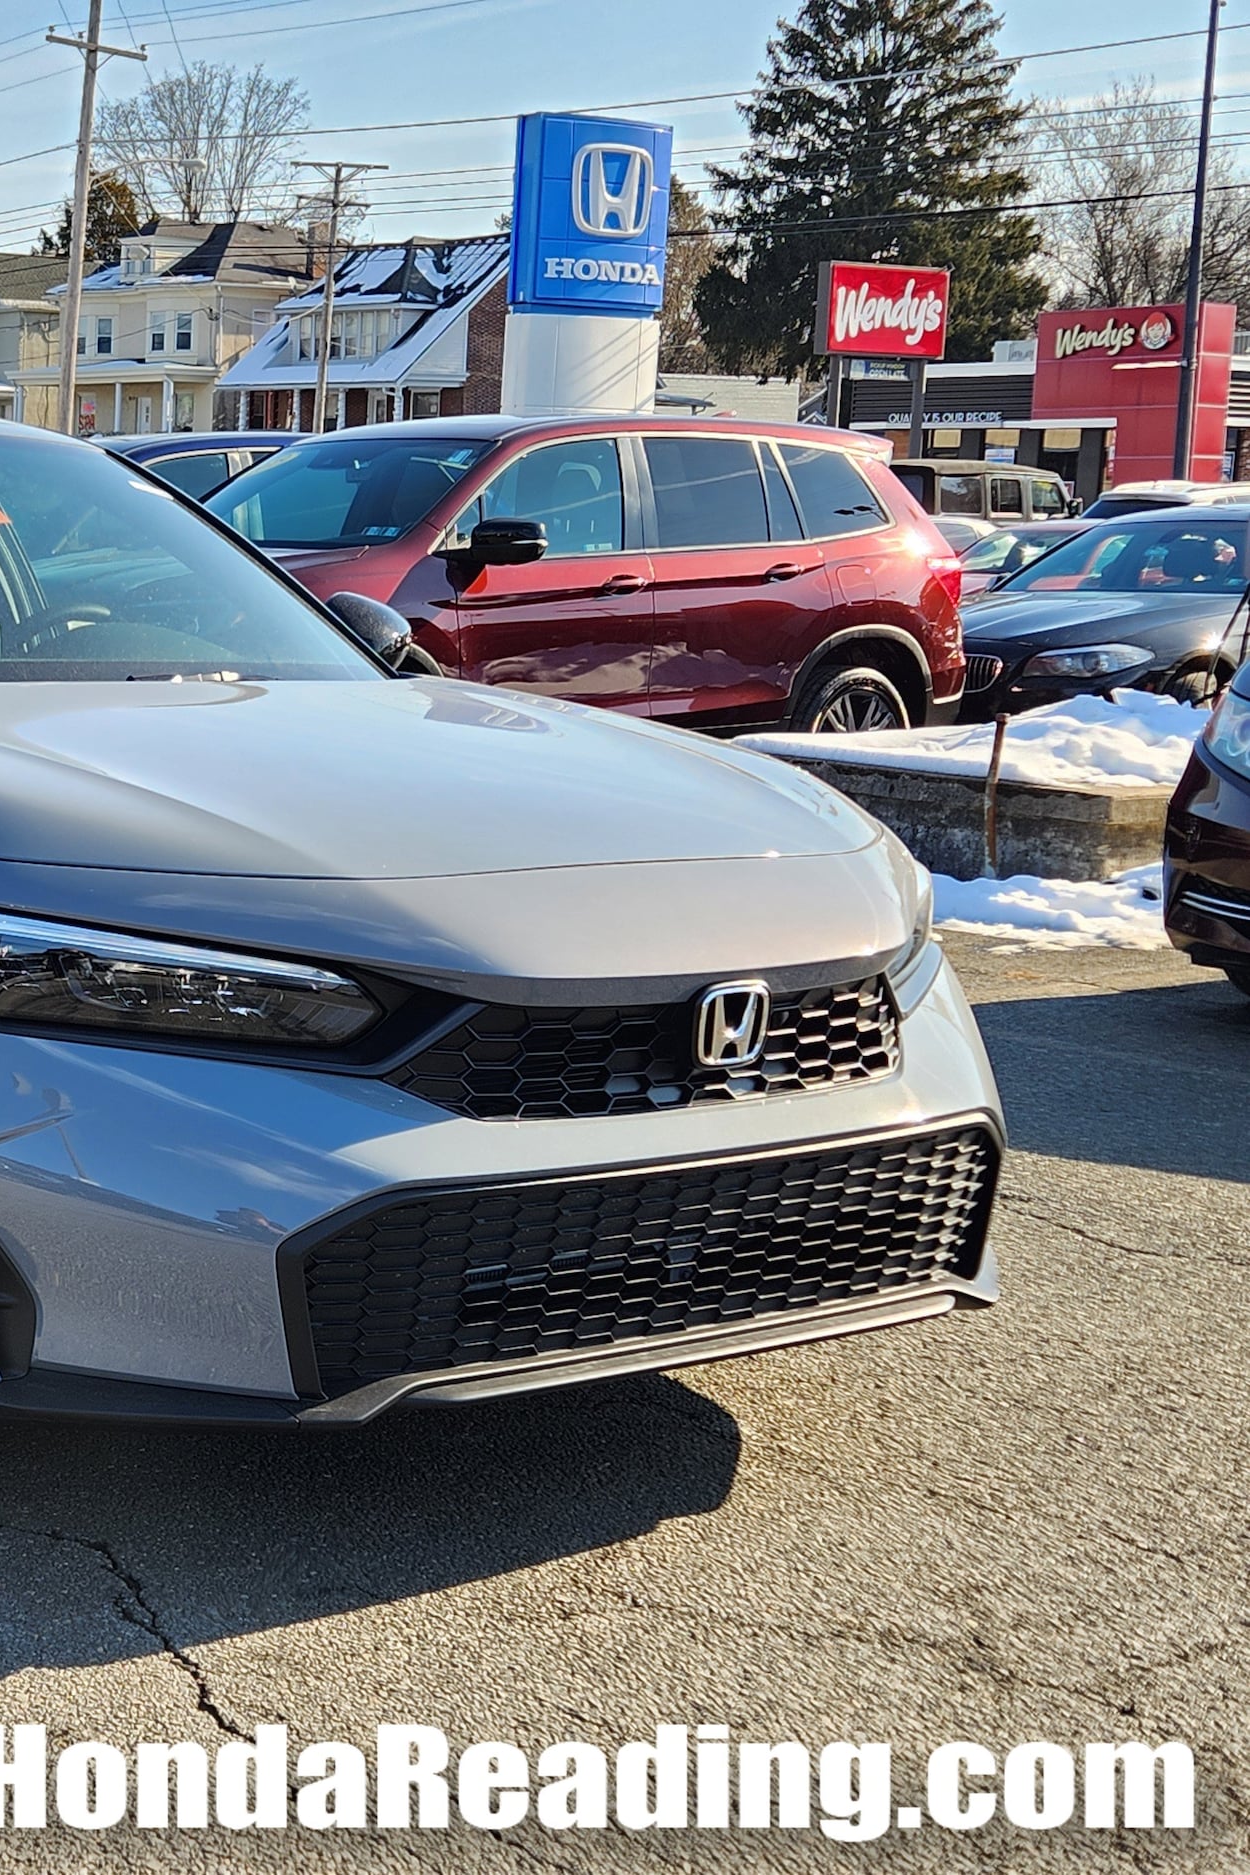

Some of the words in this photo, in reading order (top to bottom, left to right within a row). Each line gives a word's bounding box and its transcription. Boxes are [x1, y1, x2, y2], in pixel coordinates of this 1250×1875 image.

[543, 257, 661, 286] HONDA
[835, 278, 943, 346] Wendy's
[1055, 317, 1135, 359] Wendy's
[888, 412, 931, 423] QUAY
[942, 412, 964, 422] OUR
[966, 411, 1002, 422] RECIPE
